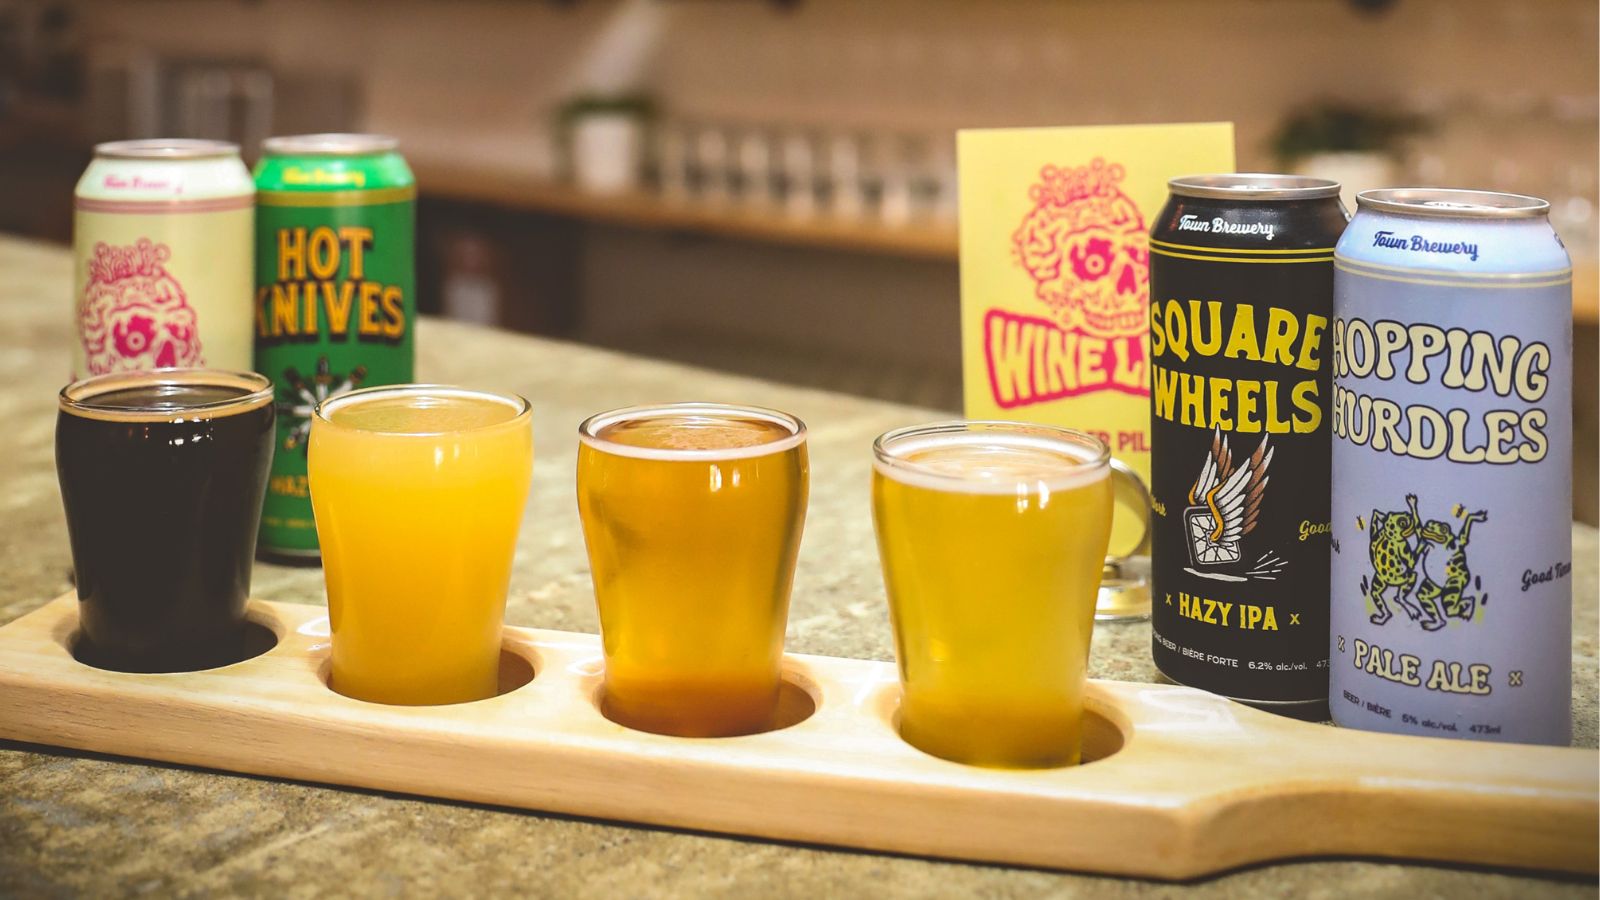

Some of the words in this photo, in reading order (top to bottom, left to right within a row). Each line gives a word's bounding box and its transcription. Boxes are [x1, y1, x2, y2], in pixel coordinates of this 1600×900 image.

[278, 226, 373, 280] HOT
[1178, 214, 1211, 232] Town
[1211, 217, 1275, 241] Brewery
[1372, 230, 1409, 250] Town
[1410, 235, 1479, 261] Brewery
[990, 316, 1108, 403] WINE
[1151, 299, 1328, 371] SQUARE
[1333, 317, 1551, 403] HOPPING
[1152, 364, 1323, 434] WHEELS
[1332, 382, 1549, 465] HURDLES
[1521, 566, 1553, 592] Good
[1179, 592, 1233, 626] HAZY
[1239, 604, 1278, 631] IPA
[1207, 654, 1239, 668] FORTE
[1248, 661, 1273, 671] 6.2%
[1354, 638, 1421, 687] PALE
[1425, 660, 1492, 696] ALE
